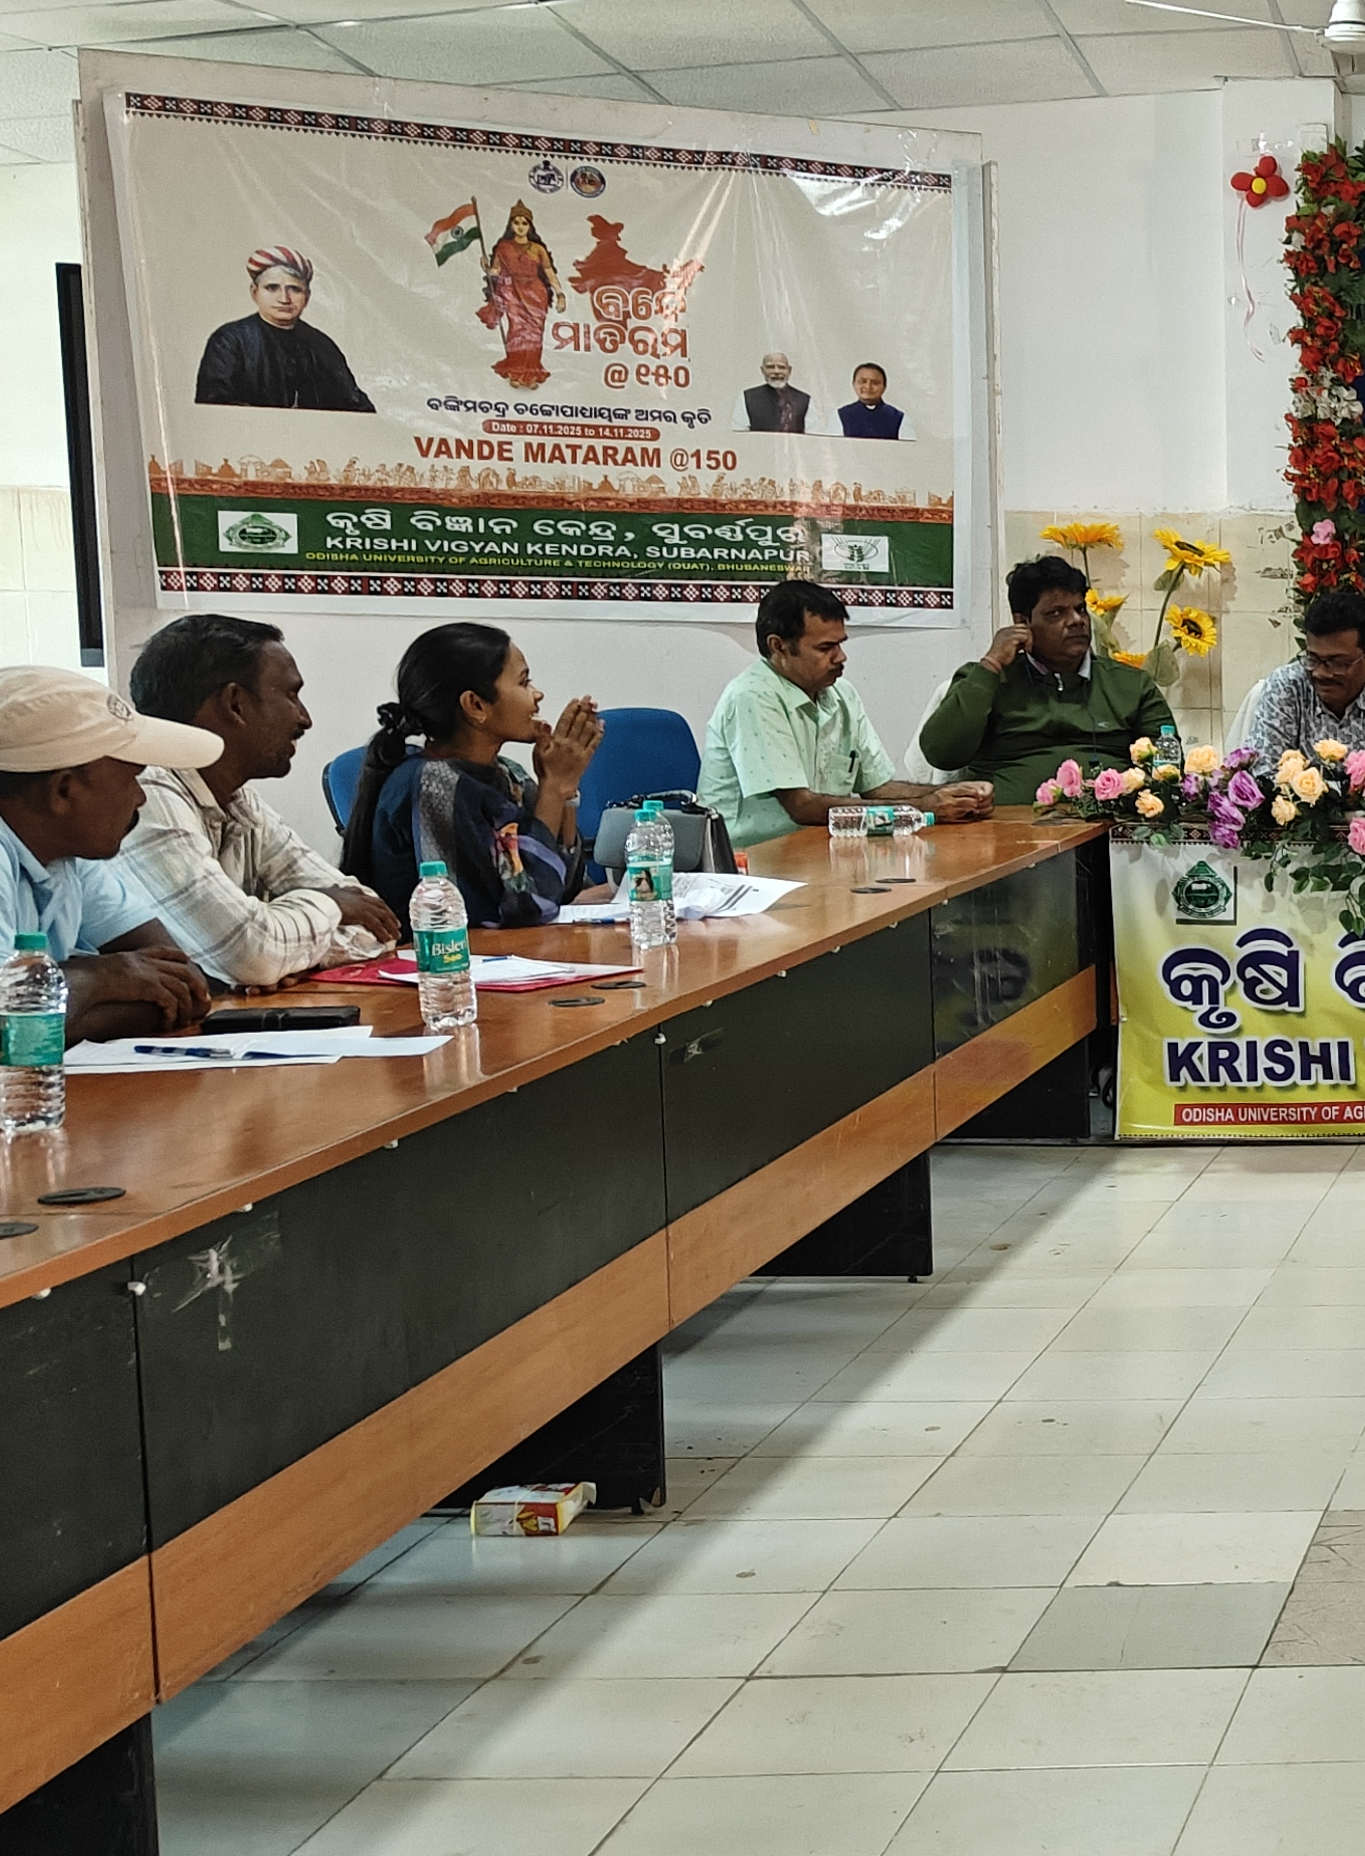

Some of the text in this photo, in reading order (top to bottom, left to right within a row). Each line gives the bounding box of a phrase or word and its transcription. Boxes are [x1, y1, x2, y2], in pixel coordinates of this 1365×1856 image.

[491, 421, 517, 433] Date
[526, 423, 582, 437] 07.11.2025
[584, 427, 596, 437] to
[599, 427, 652, 439] 14.11.2025
[634, 408, 677, 424] ଅମର
[680, 408, 712, 429] କୃତି
[414, 436, 738, 473] VANDE MATARAM @150
[326, 508, 392, 536] କୃଷି
[409, 510, 519, 535] ବିଜ୍ଞାନ
[326, 536, 810, 562] KRISHI VIGYAN KENDRA, SUBARNAPUR
[362, 553, 447, 564] UNIVERSITY
[449, 556, 466, 565] OF
[469, 557, 561, 568] AGRICULTURE
[577, 560, 665, 569] TECHNOLOGY
[1162, 928, 1300, 1029] କୃଷି
[1167, 1040, 1351, 1083] KRISHI
[1182, 1108, 1235, 1122] ODISHA
[1238, 1106, 1318, 1122] UNIVERSITY
[1321, 1106, 1340, 1121] OF
